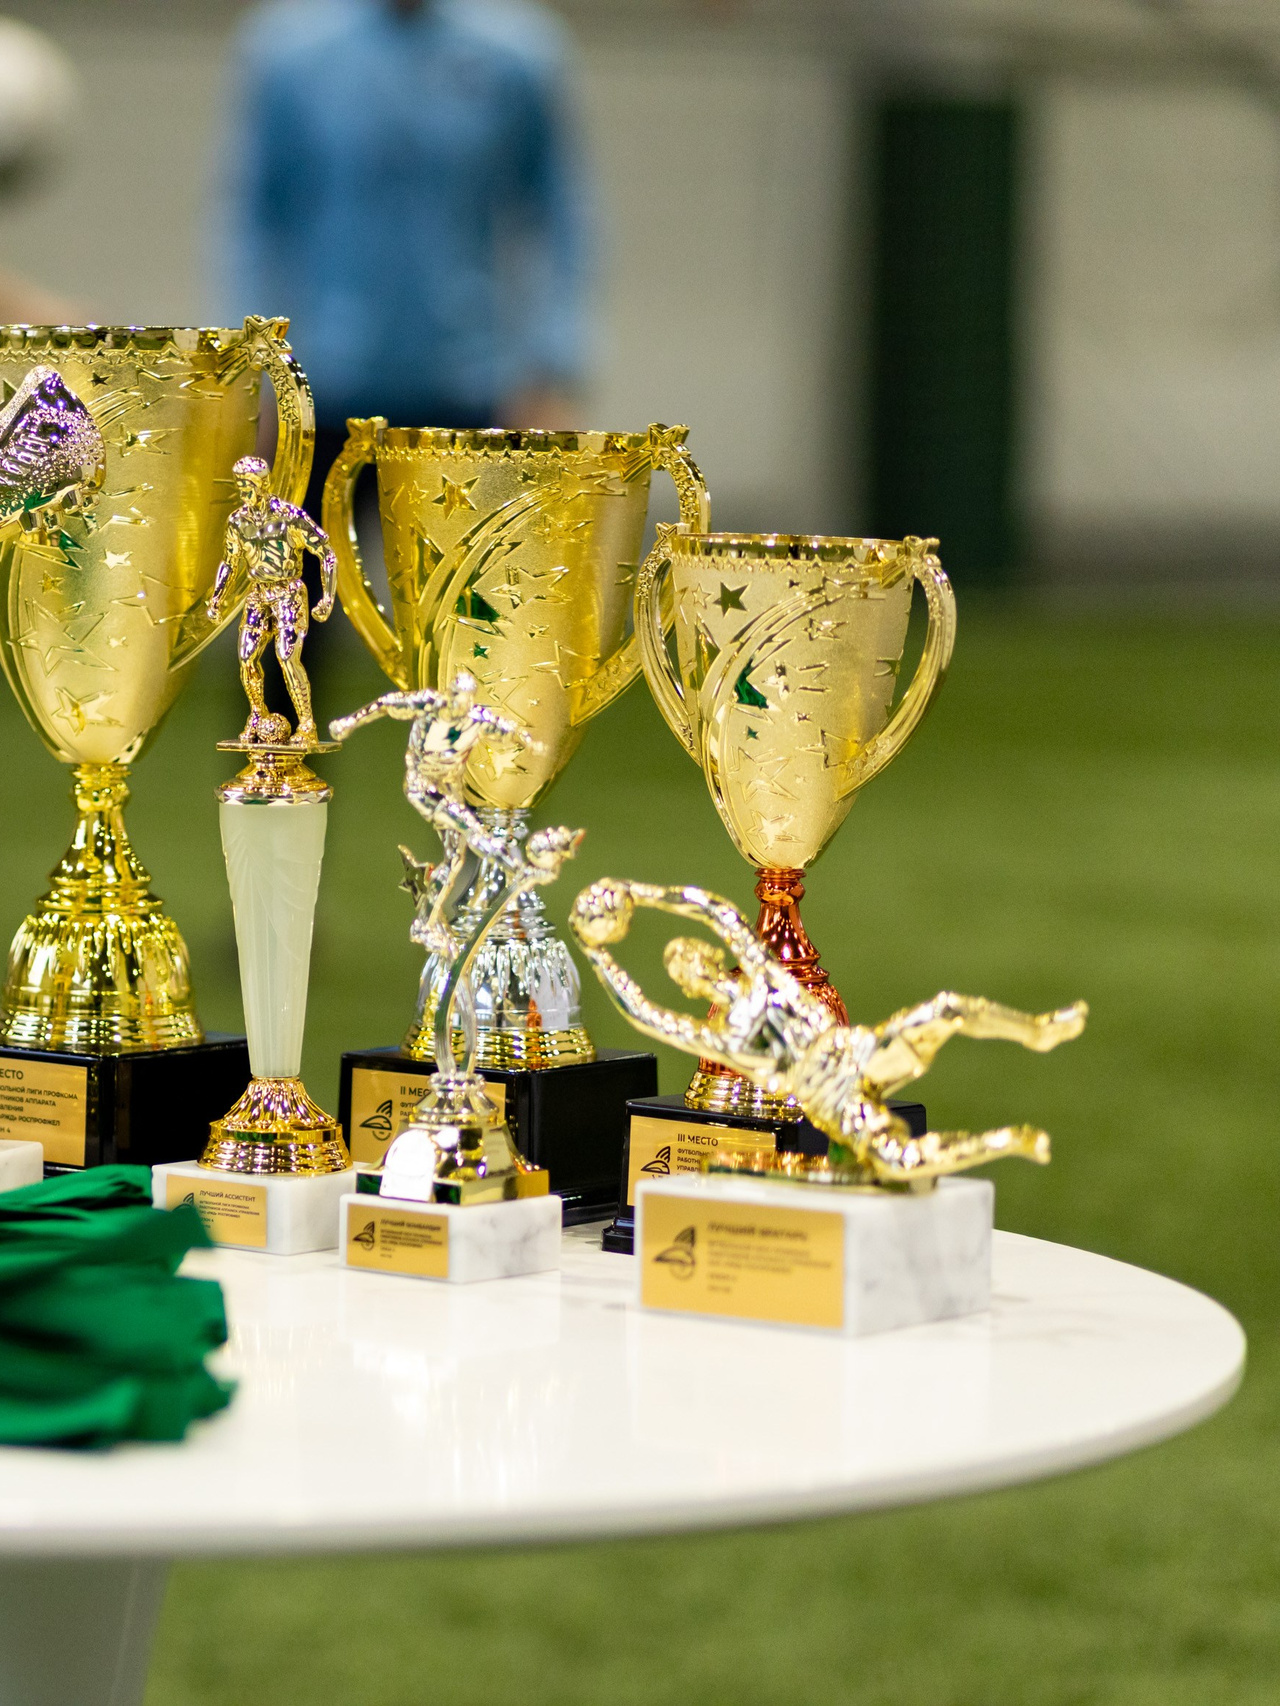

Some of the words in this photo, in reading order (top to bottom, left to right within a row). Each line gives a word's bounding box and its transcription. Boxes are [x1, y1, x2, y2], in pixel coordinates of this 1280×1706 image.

[43, 1090, 78, 1100] ПРОФКОМА
[408, 1087, 431, 1097] МЕС
[25, 1098, 56, 1106] АППАРАТА
[688, 1135, 718, 1146] МЕСТО
[200, 1190, 223, 1198] ЛУЧШИЙ
[225, 1193, 255, 1202] АССИСТЕНТ
